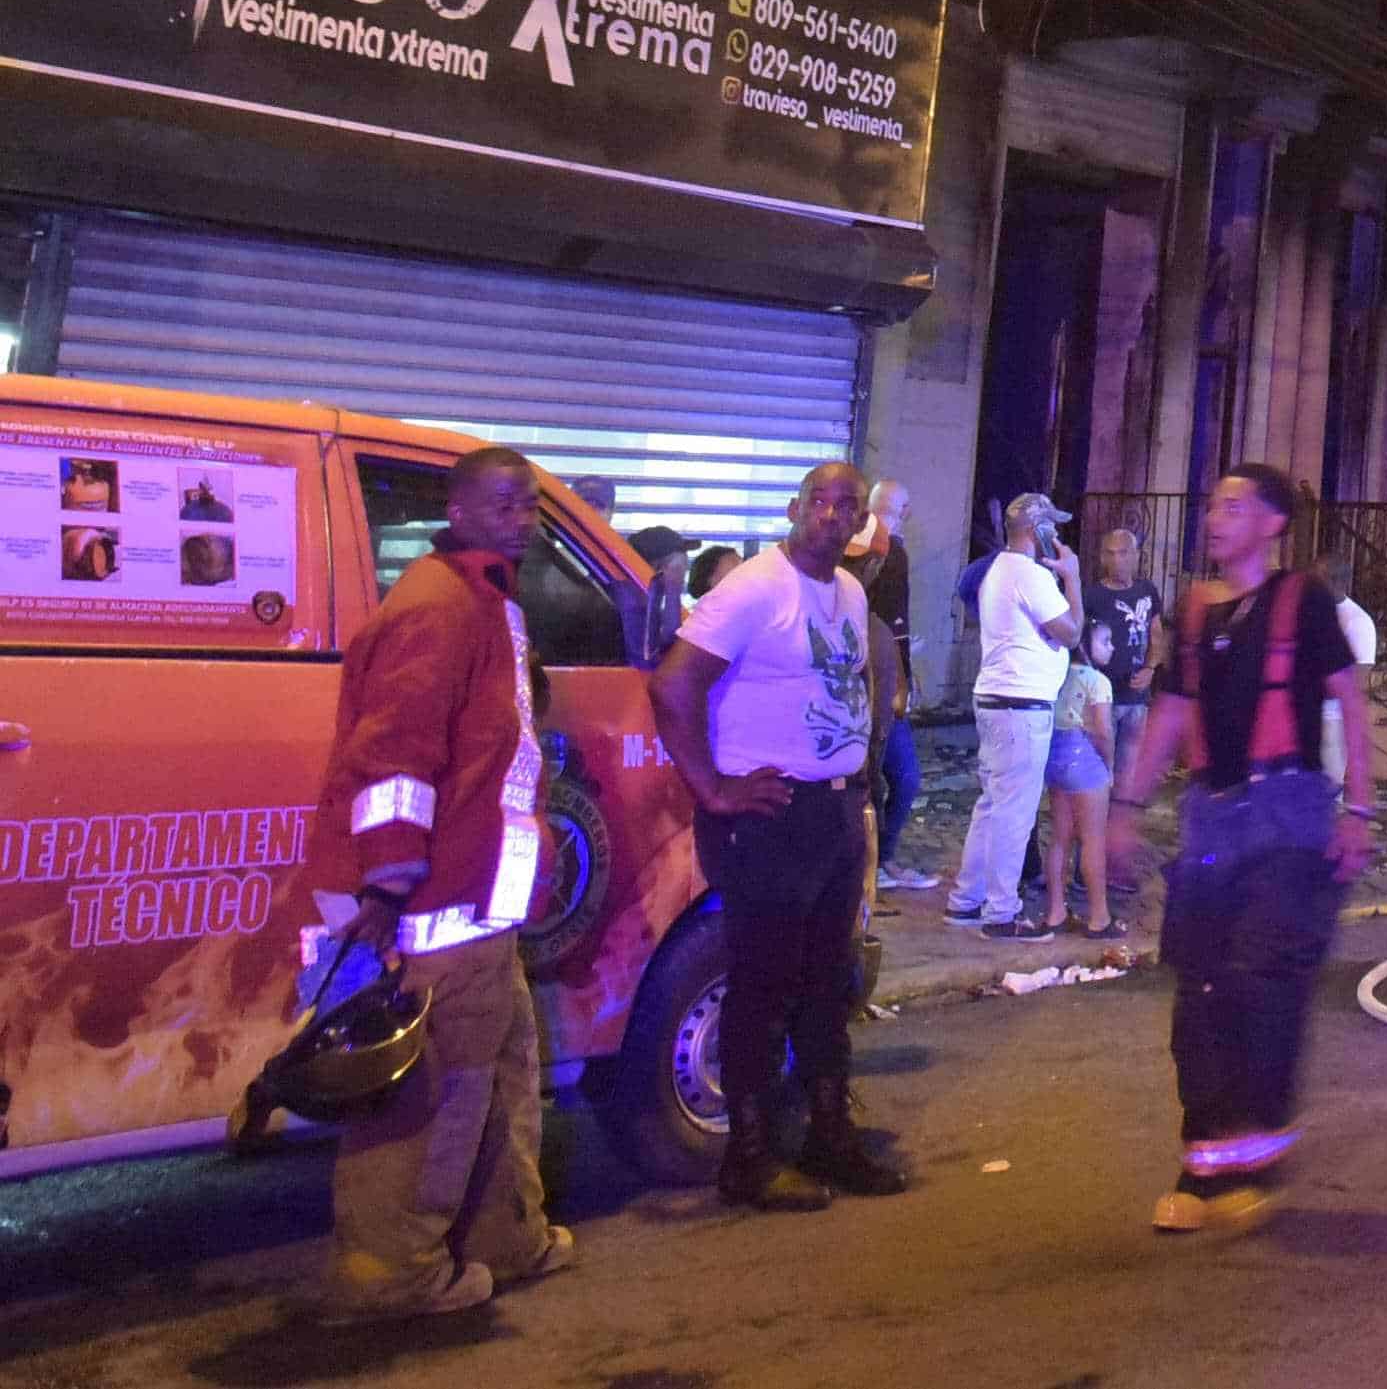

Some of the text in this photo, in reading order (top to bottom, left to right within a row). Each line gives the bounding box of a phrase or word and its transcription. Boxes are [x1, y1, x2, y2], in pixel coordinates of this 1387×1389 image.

[388, 28, 488, 81] xtrema
[749, 41, 896, 109] 829-908-5259
[623, 734, 676, 767] M-1
[68, 872, 272, 949] TÉCNICO
